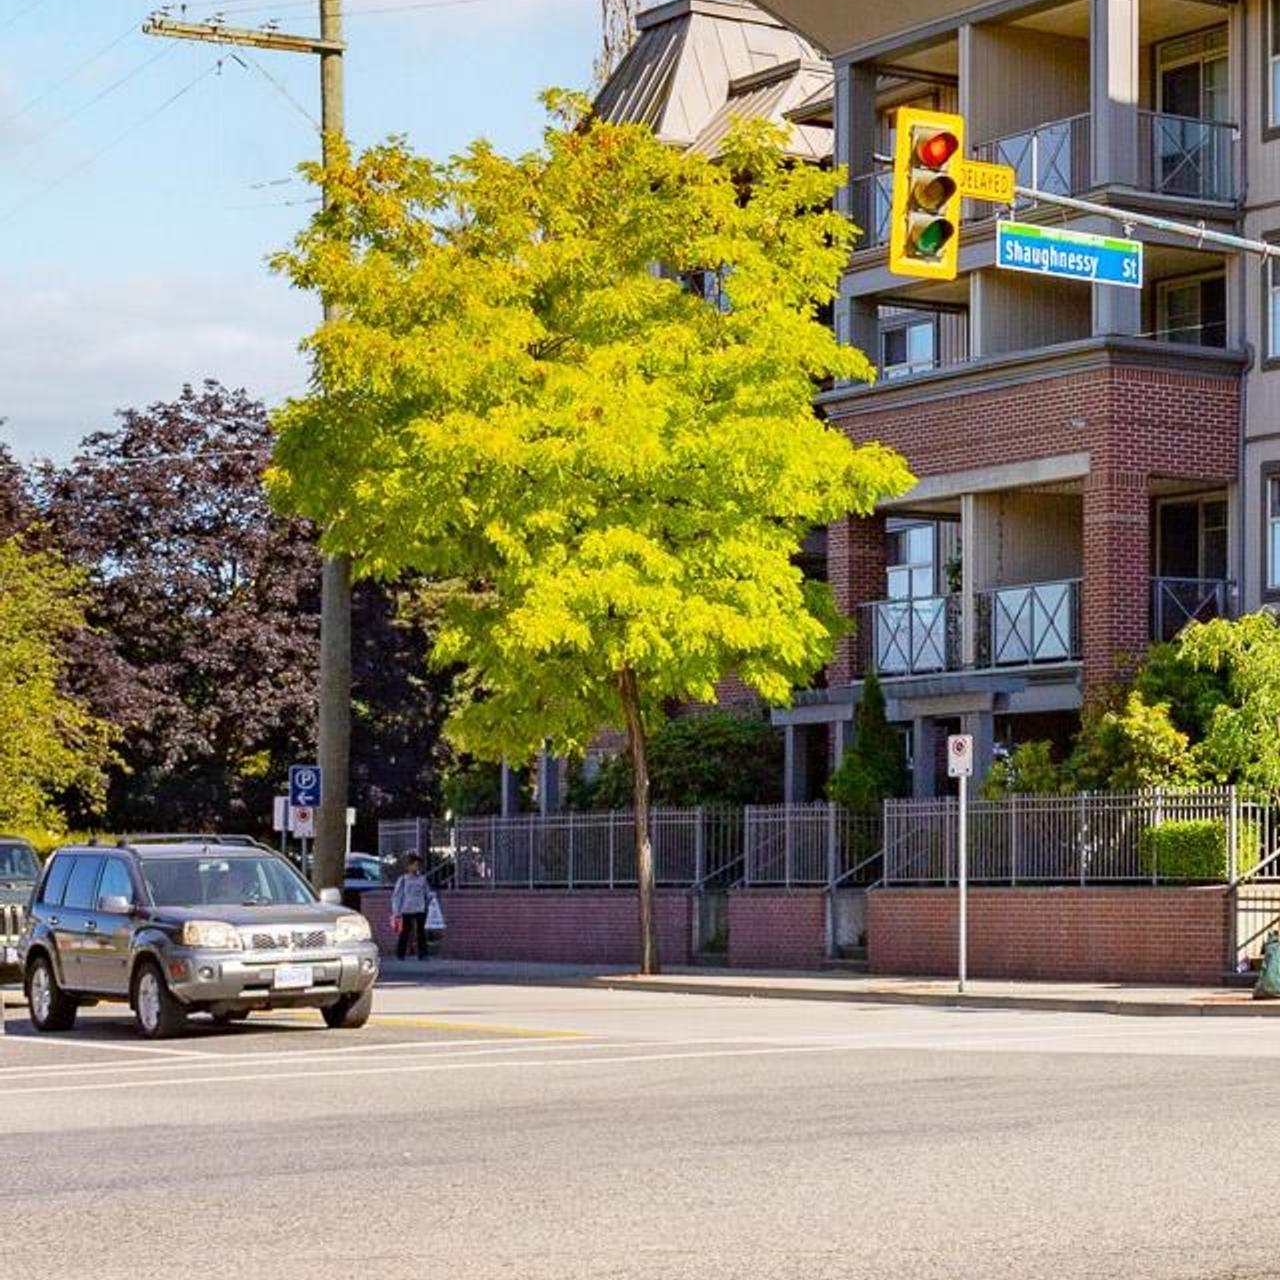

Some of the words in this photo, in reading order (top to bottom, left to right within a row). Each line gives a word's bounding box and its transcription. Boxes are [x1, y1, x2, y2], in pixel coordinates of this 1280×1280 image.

[960, 167, 1009, 194] DELAYED
[1005, 239, 1098, 279] Shaughnessy
[1122, 257, 1137, 279] St
